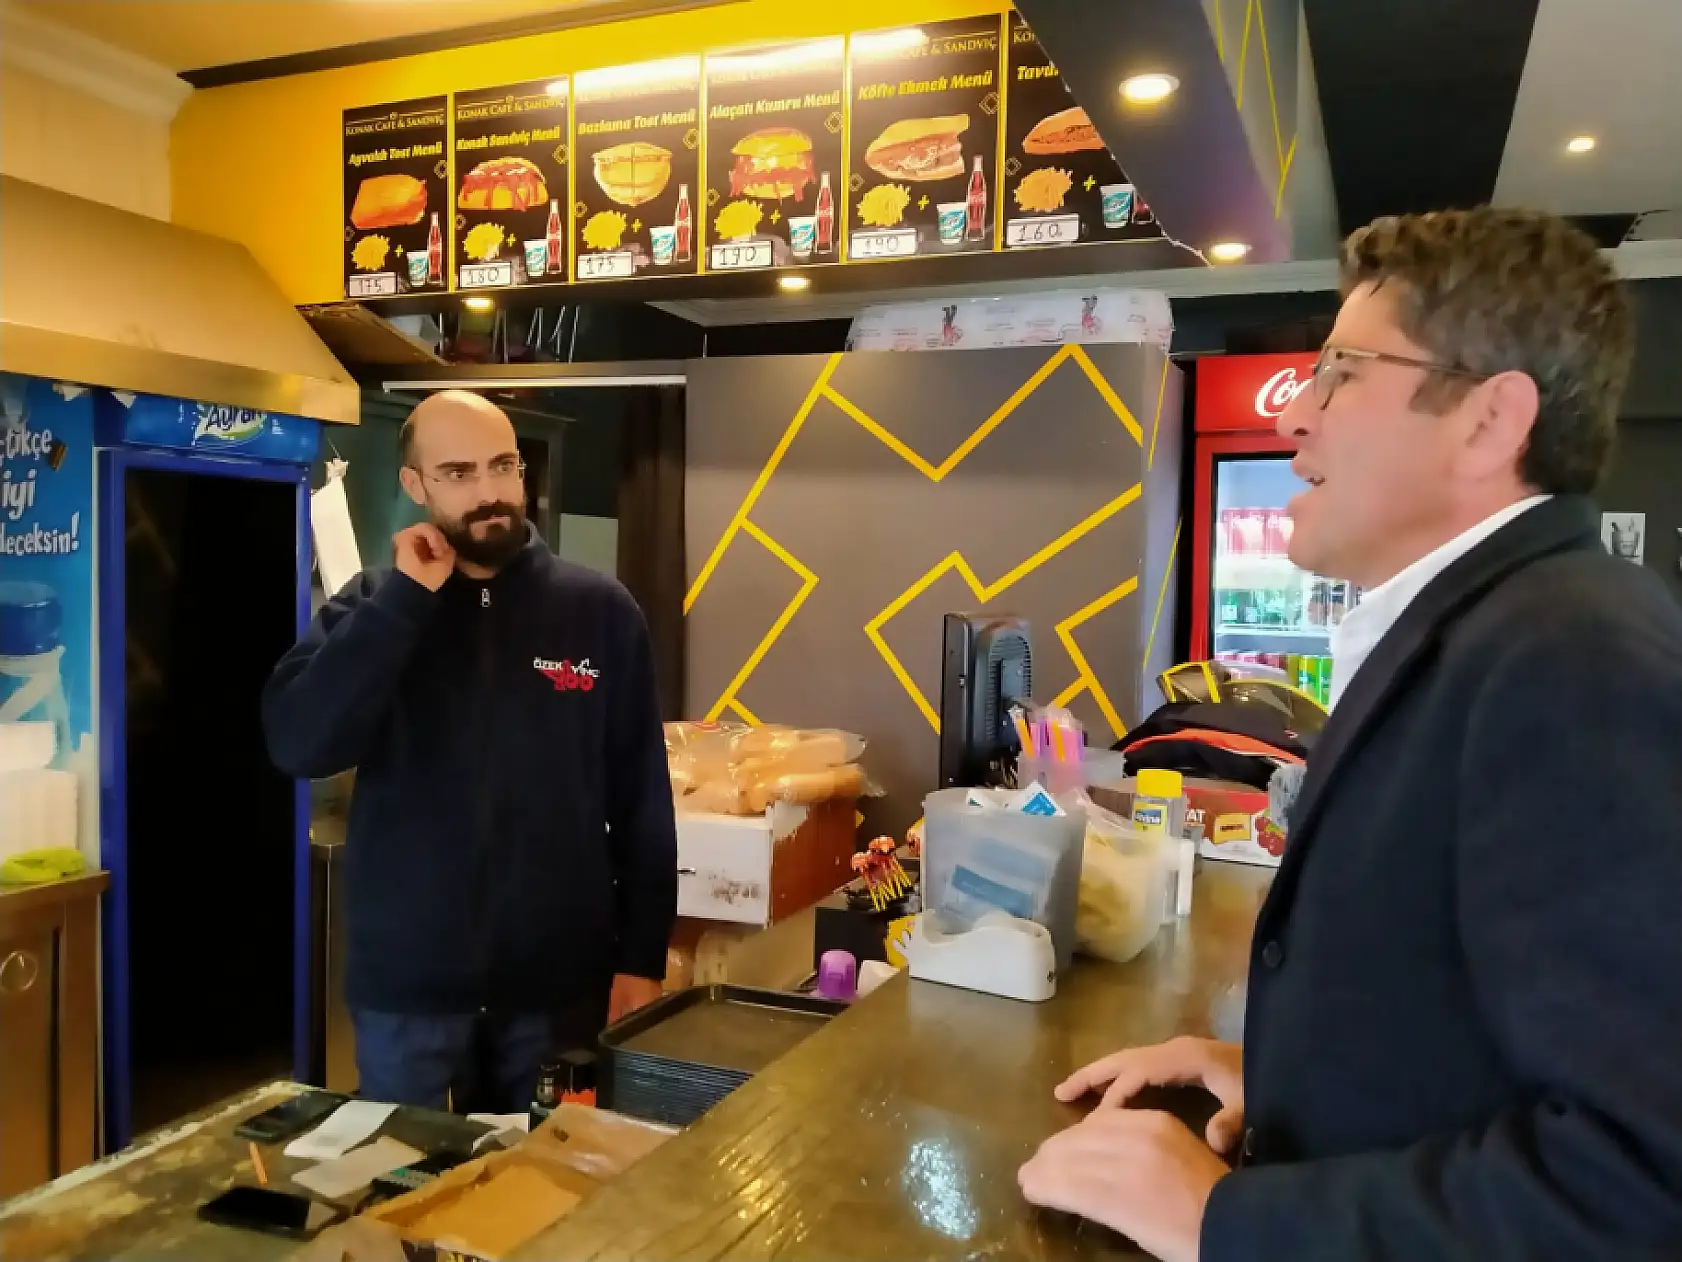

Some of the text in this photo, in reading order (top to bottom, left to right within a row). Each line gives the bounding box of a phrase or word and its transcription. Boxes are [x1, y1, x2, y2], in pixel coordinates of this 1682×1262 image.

[949, 70, 993, 89] Menü
[803, 89, 840, 109] Menü
[2, 468, 37, 520] iyi
